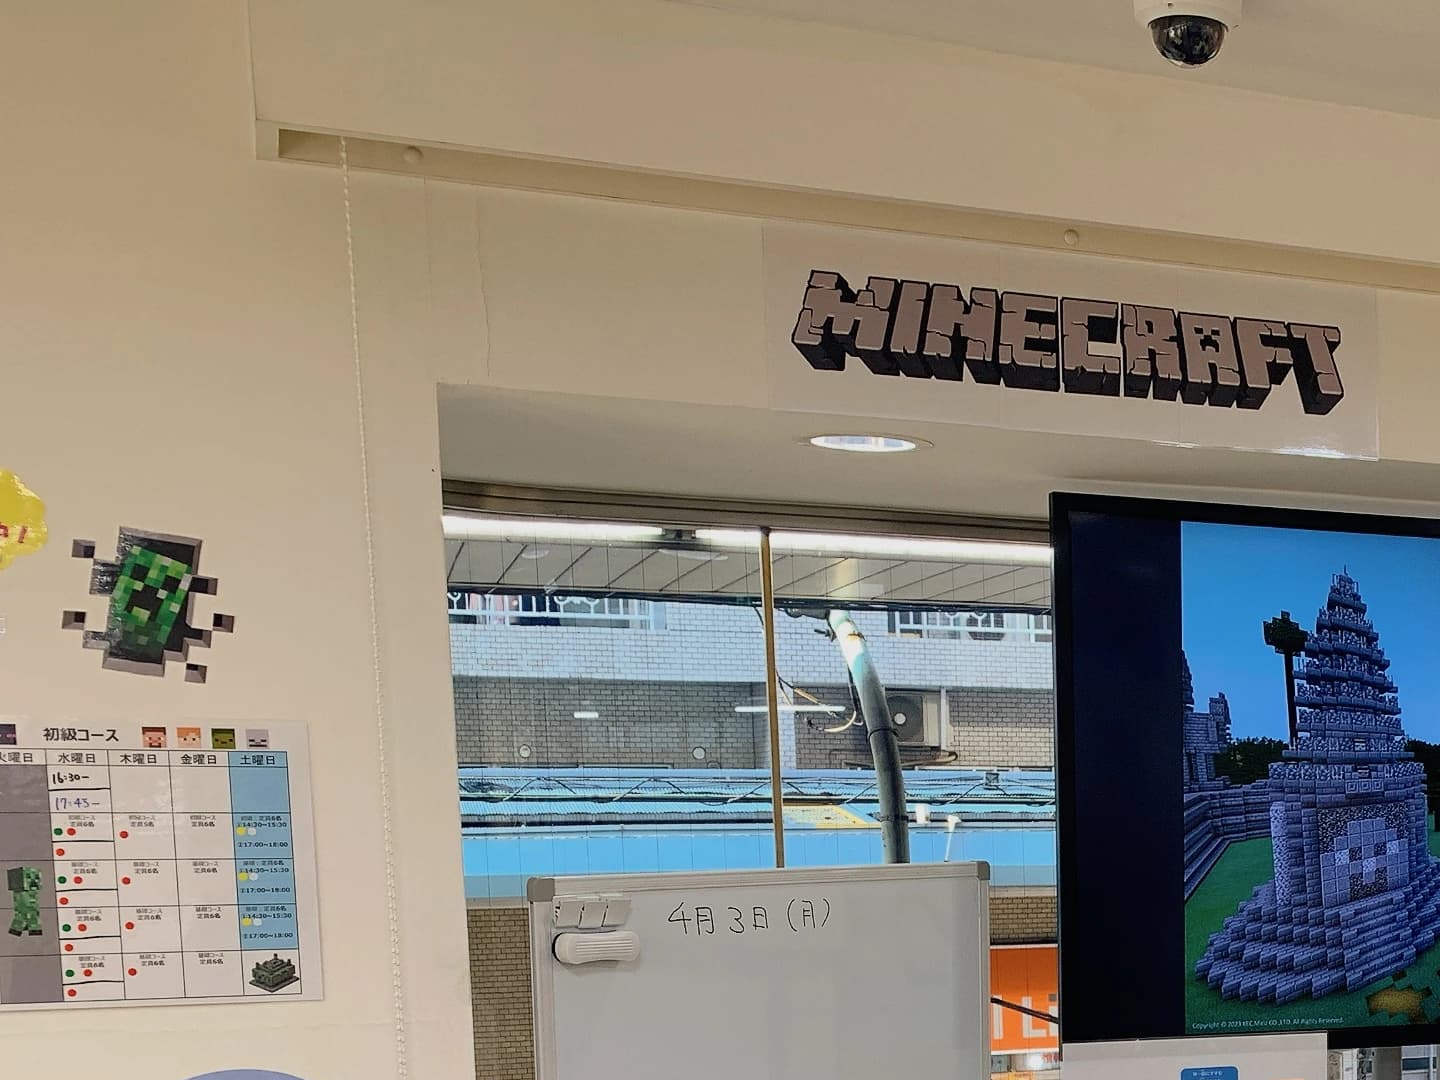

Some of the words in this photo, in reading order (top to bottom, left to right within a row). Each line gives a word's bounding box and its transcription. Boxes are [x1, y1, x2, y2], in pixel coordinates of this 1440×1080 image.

[791, 269, 1344, 416] MINECRAFT
[43, 727, 119, 742] 初級コース
[58, 753, 96, 763] 水曜日
[120, 753, 157, 764] 木曜日
[180, 754, 217, 765] 金曜日
[240, 755, 276, 765] 土曜日
